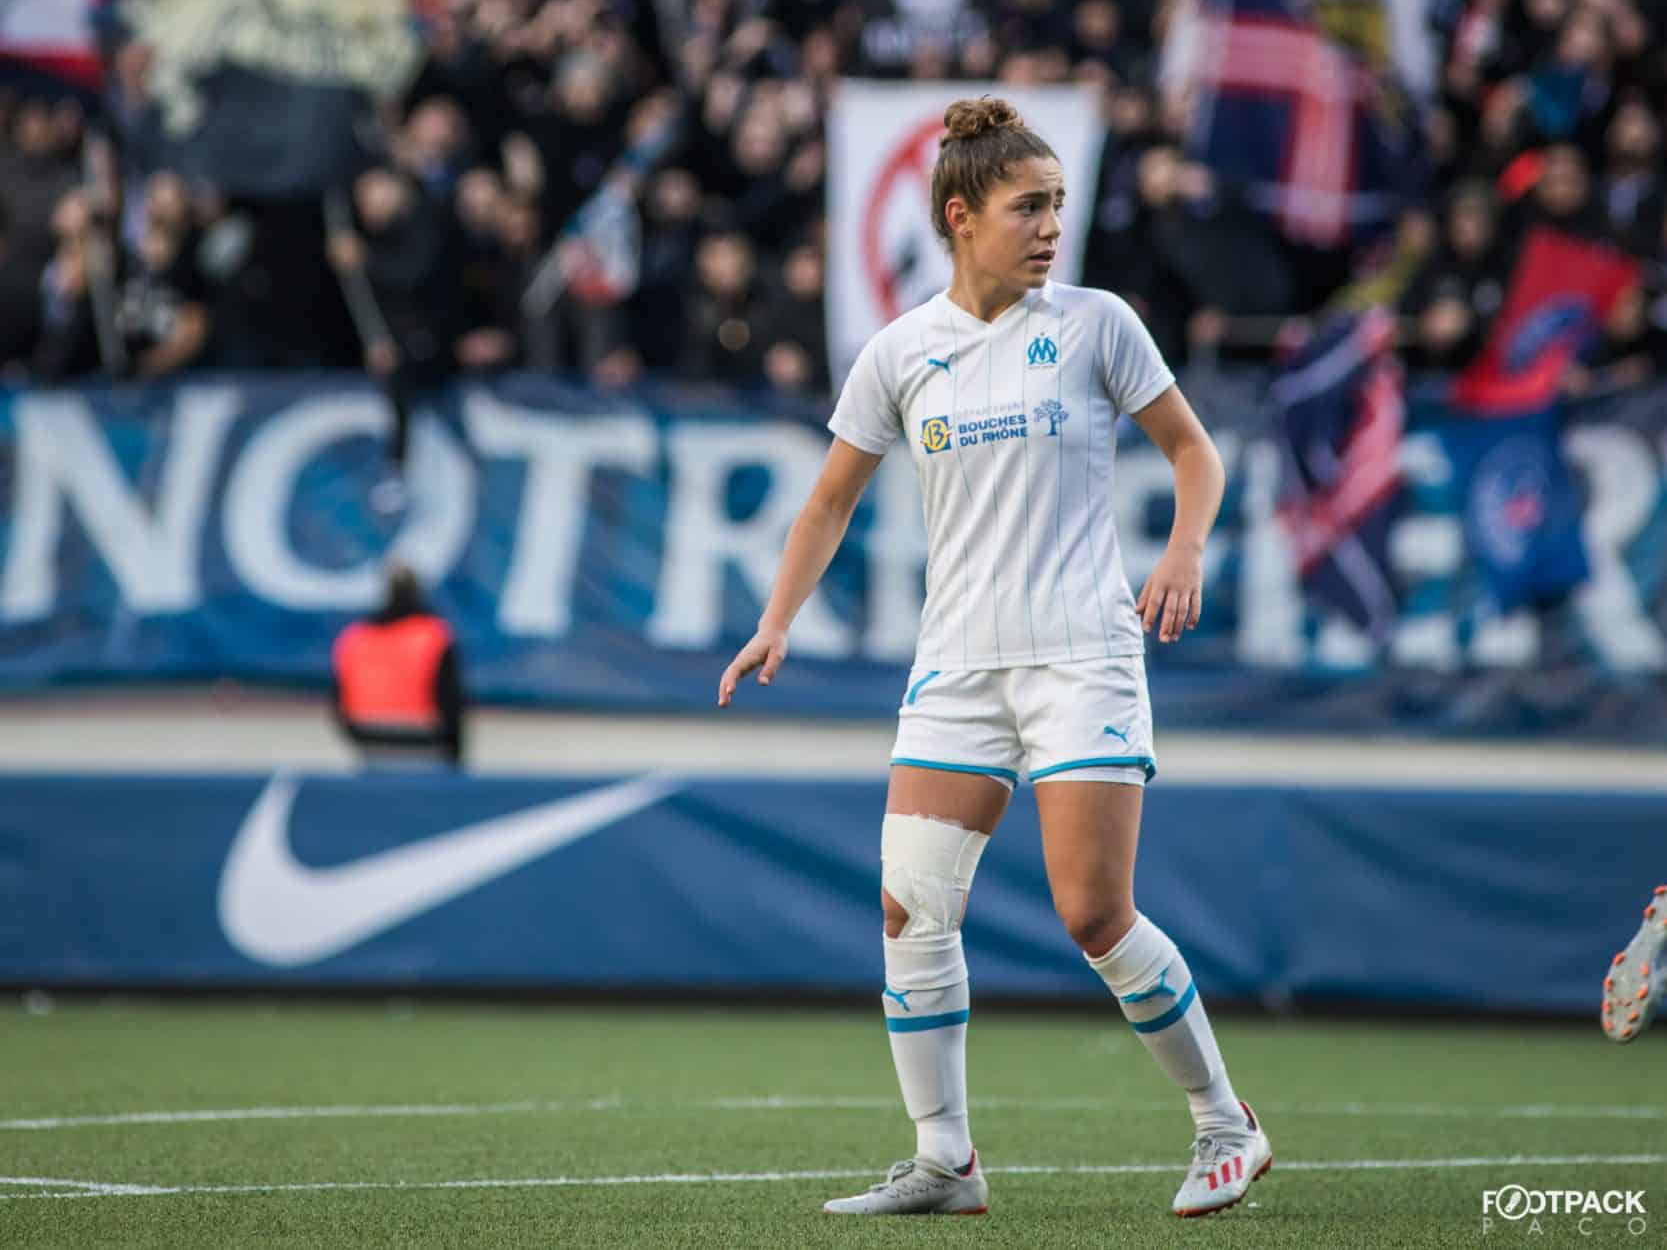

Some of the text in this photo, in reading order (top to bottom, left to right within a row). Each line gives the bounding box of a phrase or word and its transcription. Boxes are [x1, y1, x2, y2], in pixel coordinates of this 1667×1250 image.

[958, 414, 1027, 434] BOUCHES
[959, 426, 1029, 447] DU RHÔNE
